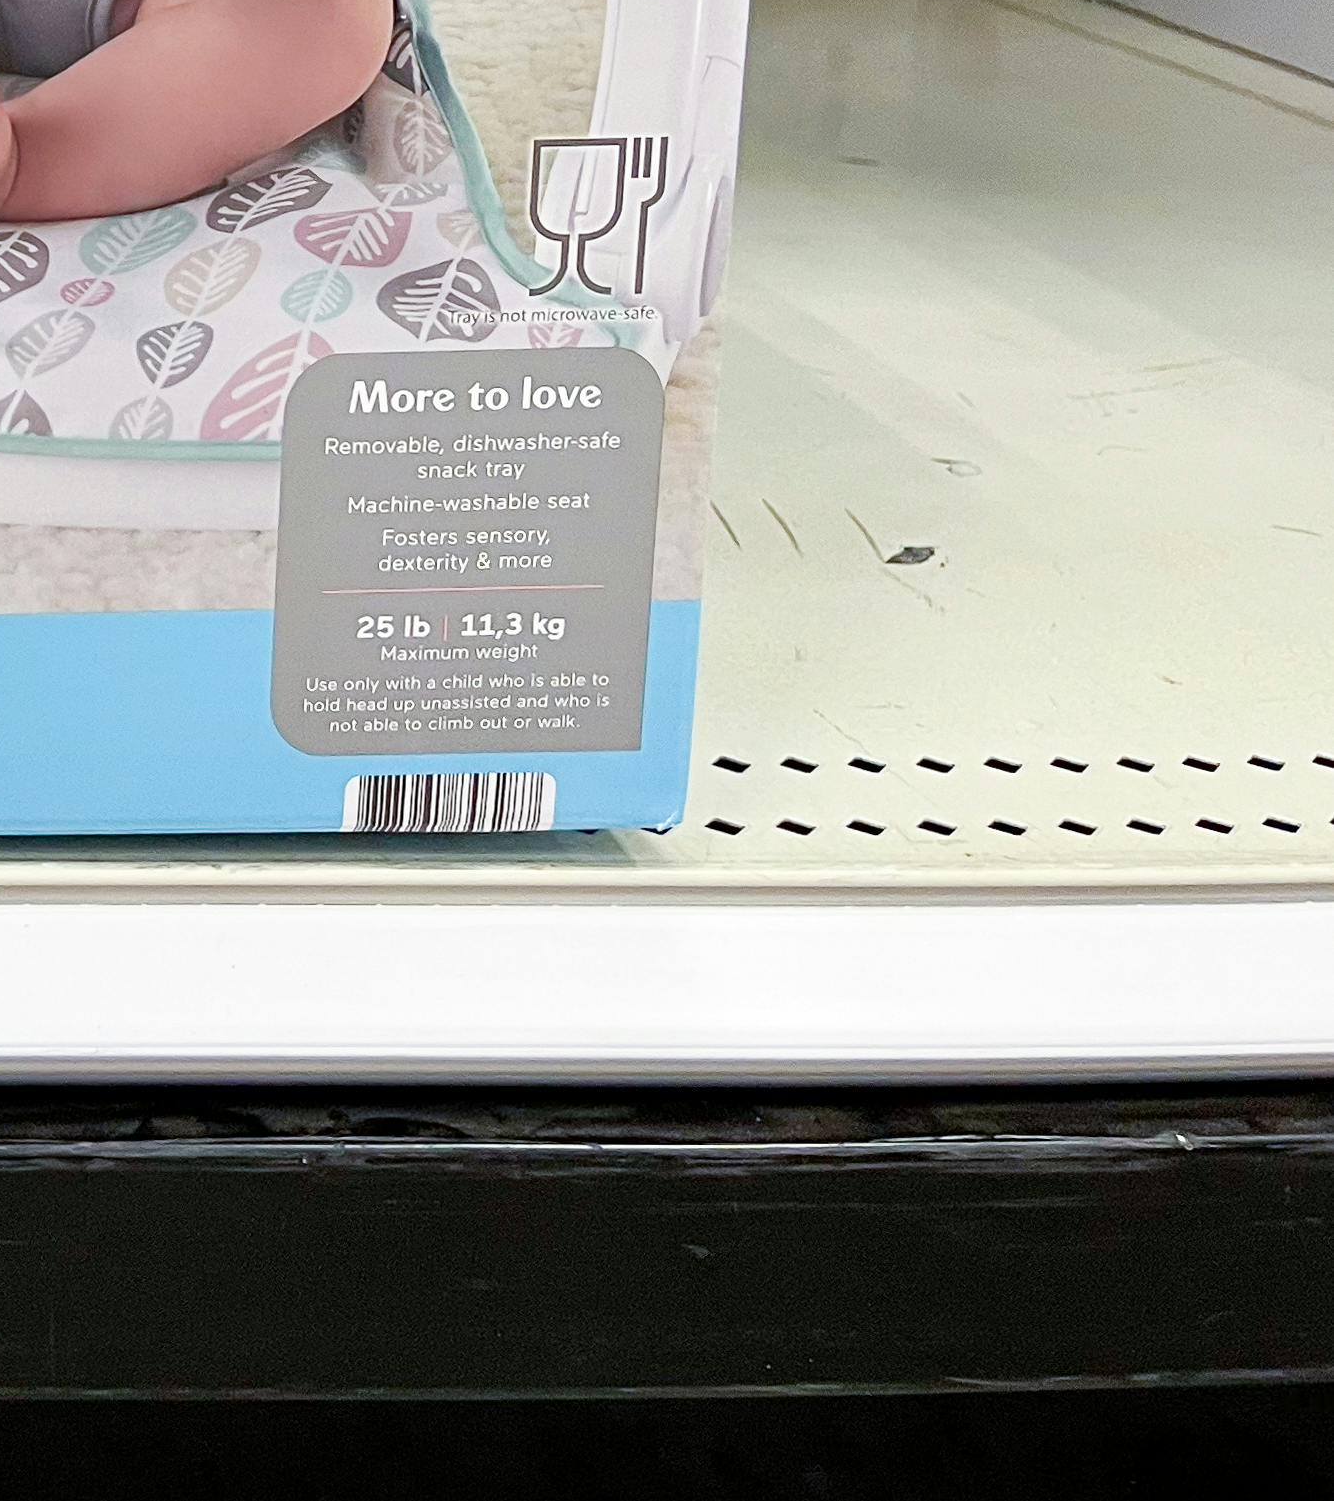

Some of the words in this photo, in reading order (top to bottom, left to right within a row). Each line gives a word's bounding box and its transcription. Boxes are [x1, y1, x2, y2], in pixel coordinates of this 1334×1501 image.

[448, 309, 480, 326] Tray
[484, 309, 495, 323] is
[500, 308, 527, 322] not
[531, 304, 658, 323] microwave-safe.
[349, 380, 456, 414] More
[468, 382, 509, 411] to
[522, 375, 602, 410] love
[324, 436, 444, 455] Removable,
[453, 431, 621, 452] dishwasher-safe
[417, 460, 477, 479] snack
[485, 461, 525, 480] tray
[348, 493, 540, 514] Machine-washable
[547, 493, 590, 509] seat
[382, 528, 458, 546] Fosters
[465, 527, 551, 546] sensory,
[378, 553, 469, 573] dexterity
[476, 552, 492, 570] &
[498, 554, 553, 569] more
[356, 615, 395, 639] 25
[403, 615, 431, 638] lb
[460, 613, 523, 640] 11,3
[531, 612, 566, 640] kg
[380, 645, 469, 661] Maximum
[475, 643, 539, 663] weight
[306, 677, 337, 692] Use
[343, 676, 380, 694] only
[384, 675, 421, 691] with
[426, 679, 437, 690] a
[442, 674, 483, 690] child
[487, 673, 525, 689] who
[531, 674, 545, 688] is
[549, 672, 587, 688] able
[591, 672, 610, 687] to
[302, 698, 341, 713] hold
[346, 697, 388, 713] head
[393, 700, 415, 714] up
[420, 694, 511, 711] unassisted
[516, 695, 549, 709] and
[553, 694, 590, 708] who
[595, 693, 610, 708] is
[329, 719, 357, 733] not
[363, 716, 399, 732] able
[404, 717, 422, 731] to
[428, 715, 474, 731] climb
[479, 716, 508, 730] out
[513, 717, 532, 729] or
[537, 714, 581, 729] walk.
